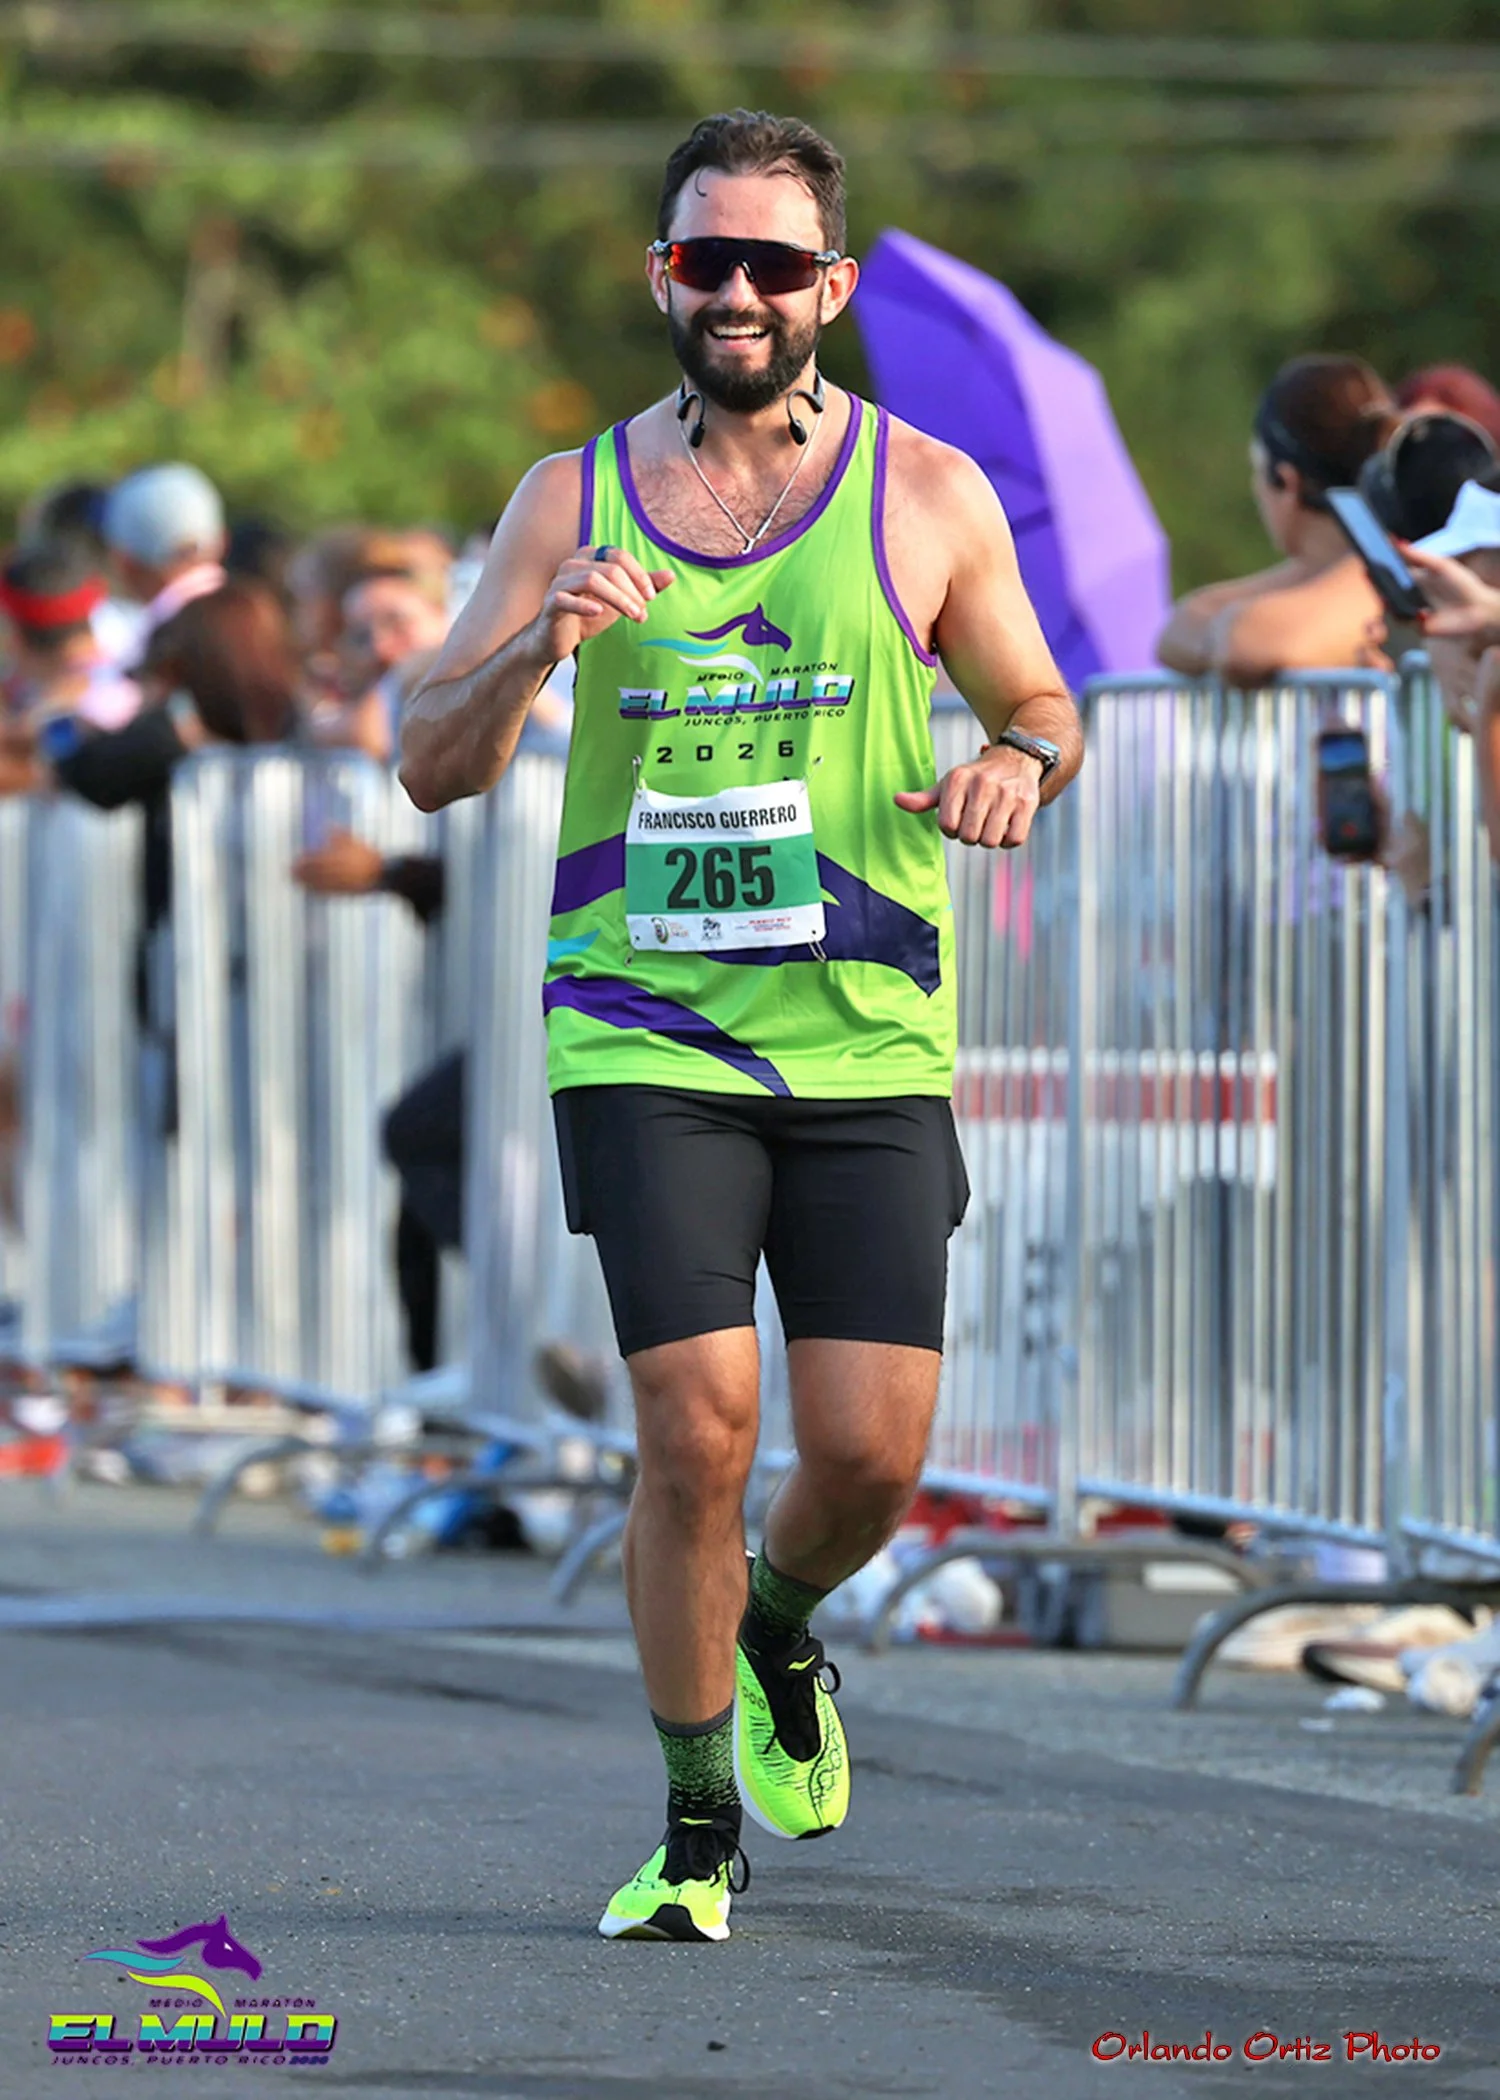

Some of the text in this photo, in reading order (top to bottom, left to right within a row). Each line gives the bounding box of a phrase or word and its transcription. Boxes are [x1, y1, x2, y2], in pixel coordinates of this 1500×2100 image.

[770, 662, 838, 676] MARATÓN
[618, 674, 855, 720] EL MULO
[684, 708, 846, 727] JUNCOS, PUERTO RICO
[656, 740, 794, 764] 2026
[638, 804, 798, 830] FRANCISCO GUERRERO
[664, 845, 776, 910] 265
